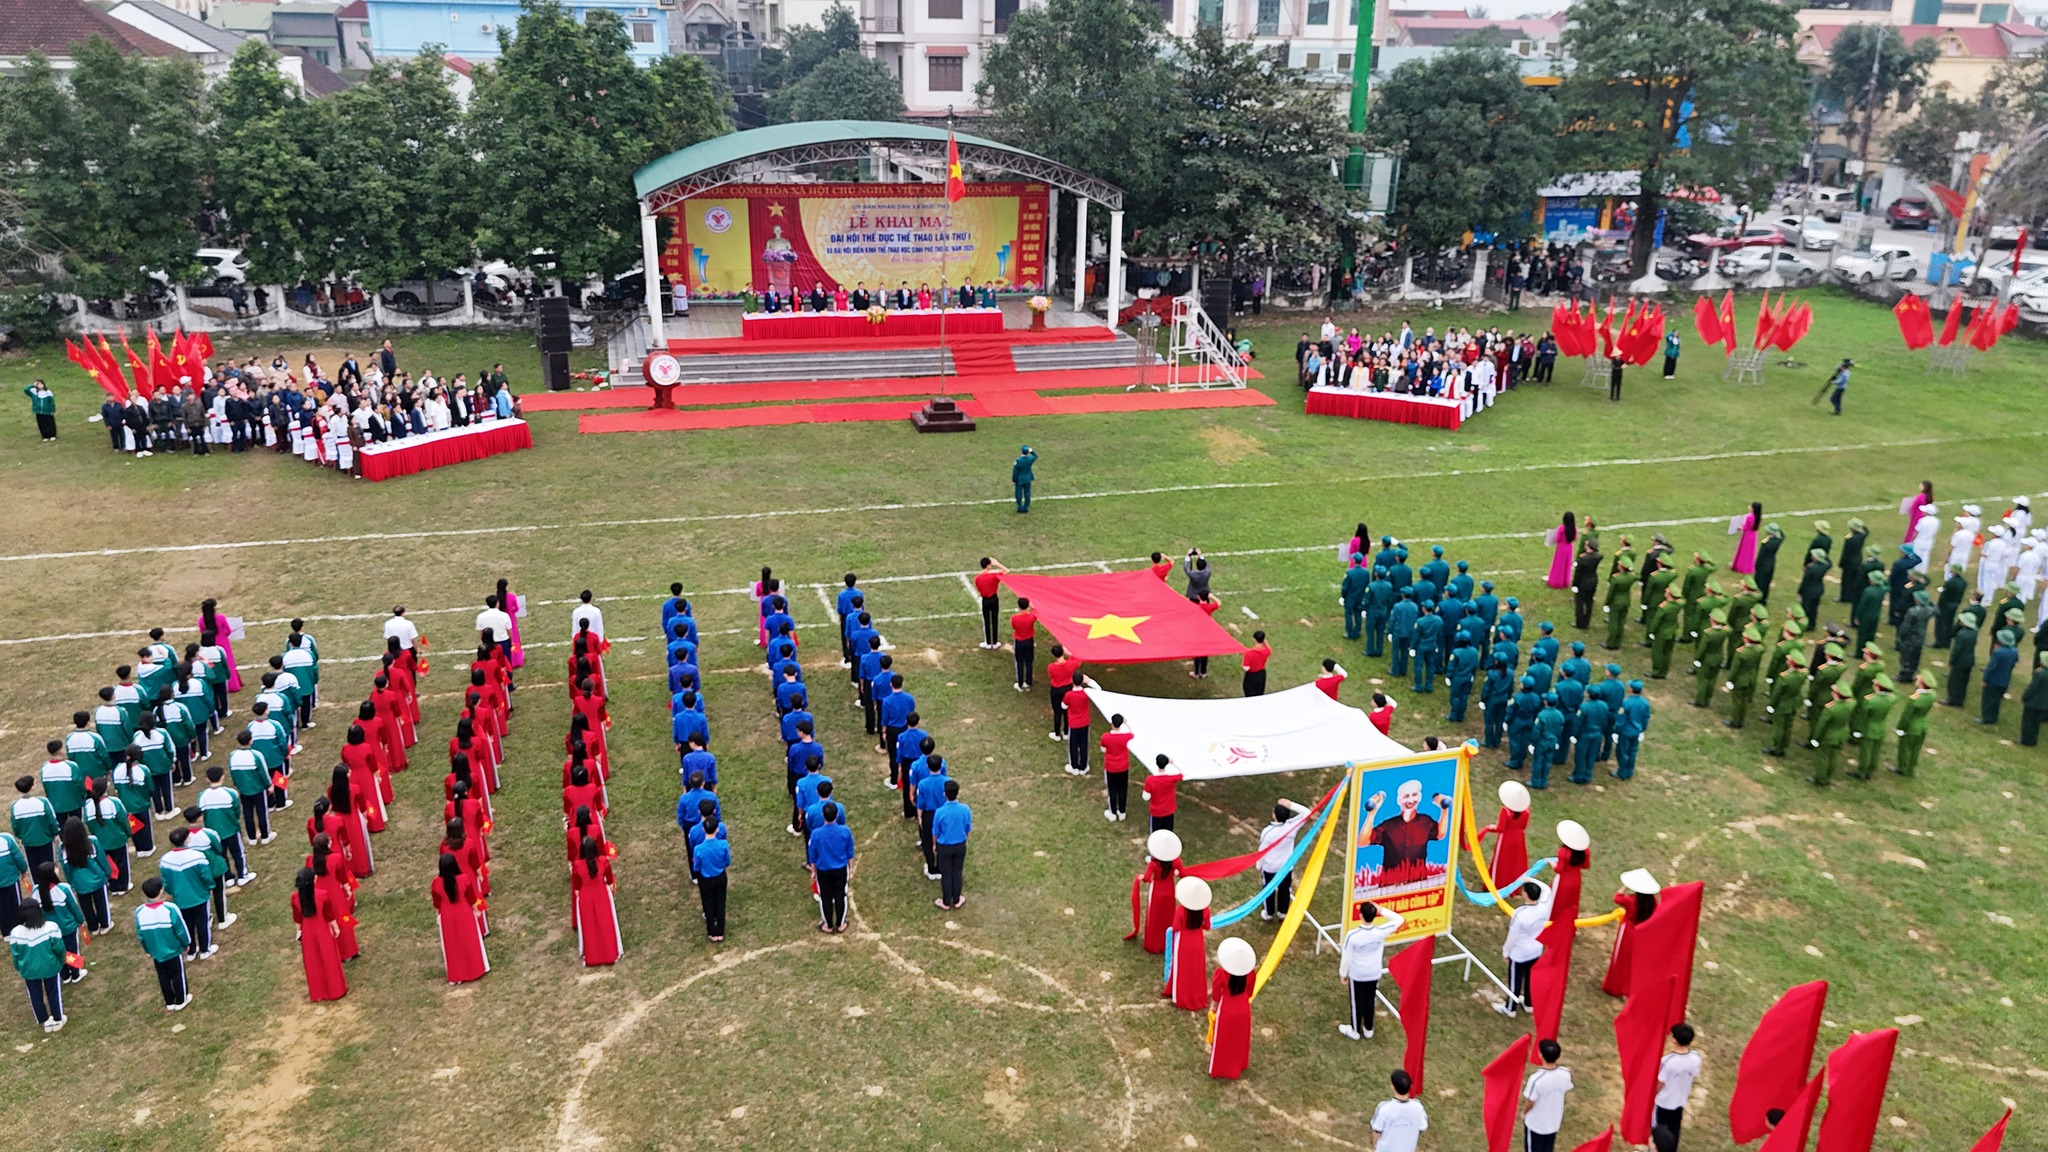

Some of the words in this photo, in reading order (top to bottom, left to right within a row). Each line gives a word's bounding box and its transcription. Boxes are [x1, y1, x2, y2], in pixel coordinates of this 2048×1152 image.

[850, 211, 869, 229] LỄ
[875, 217, 913, 228] KHAI
[831, 234, 844, 244] ĐẠI
[846, 233, 860, 244] HỘI
[862, 231, 877, 243] THỂ
[879, 234, 895, 244] DỤC
[897, 230, 911, 243] THỂ
[913, 233, 933, 242] THAO
